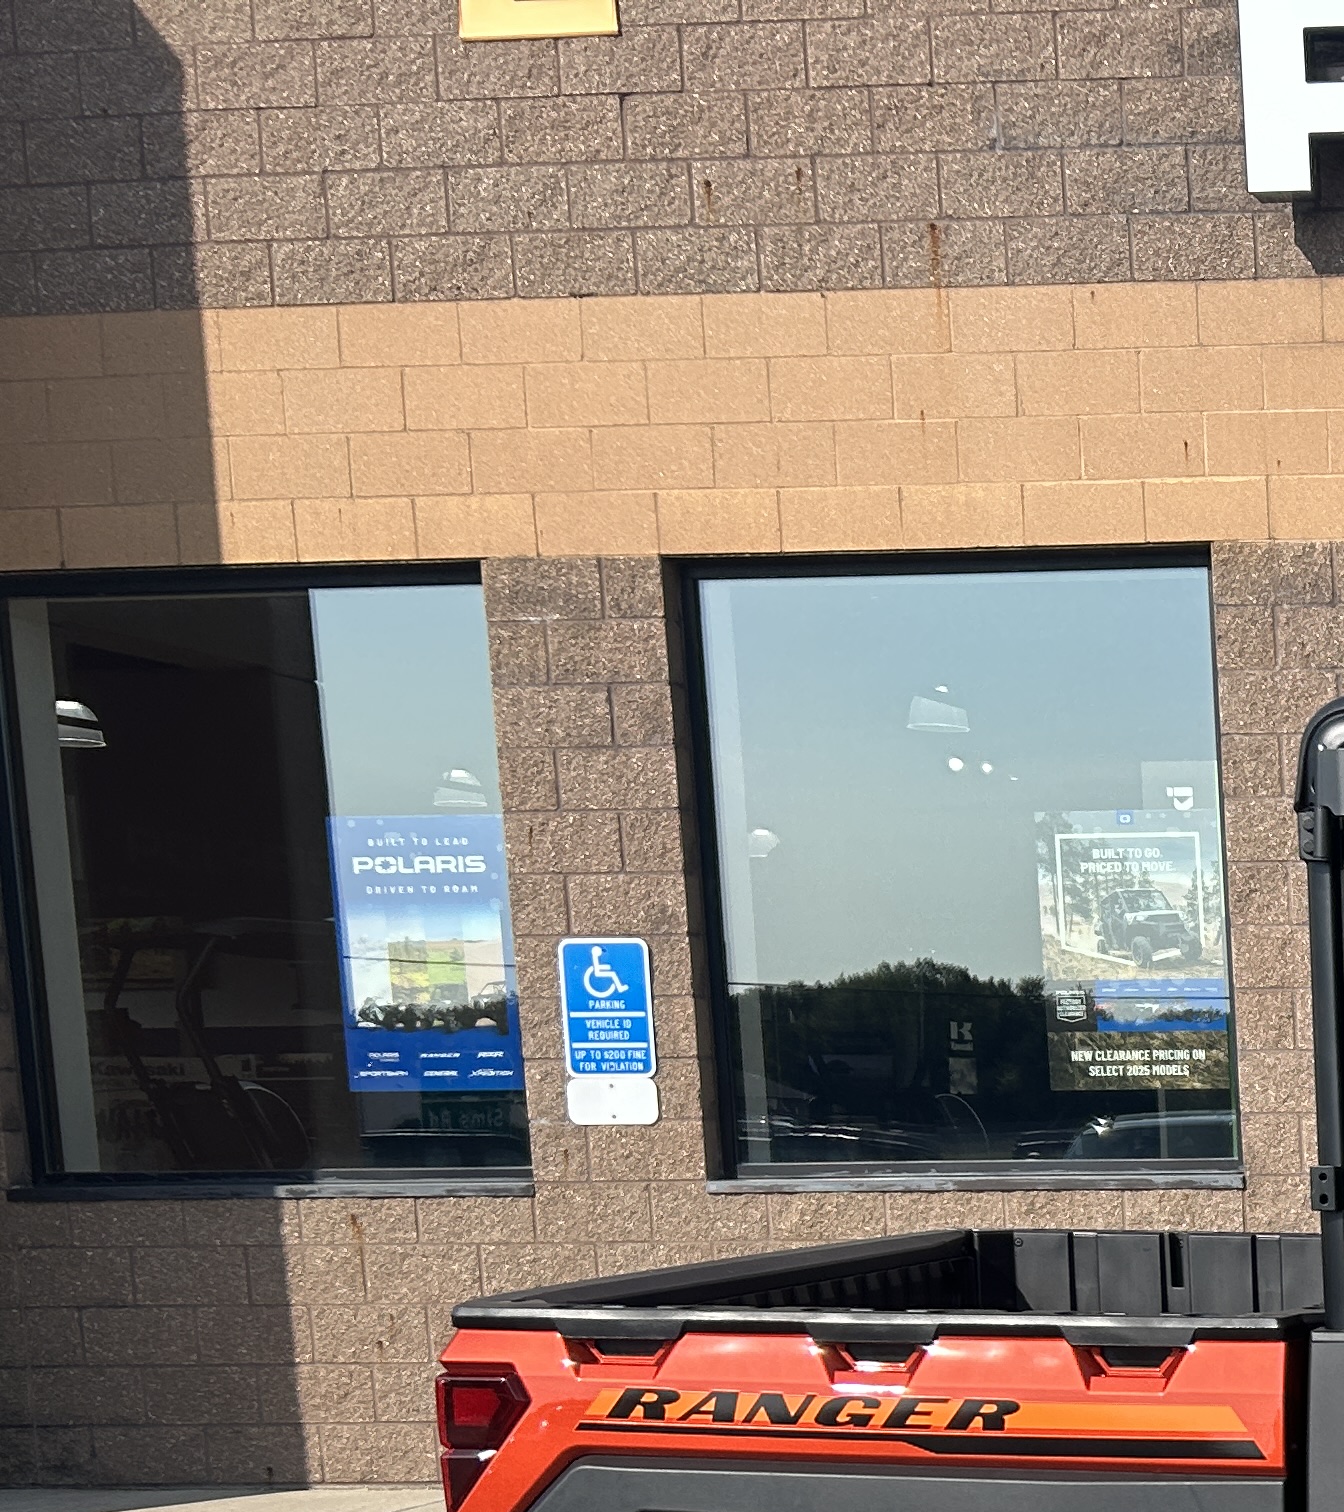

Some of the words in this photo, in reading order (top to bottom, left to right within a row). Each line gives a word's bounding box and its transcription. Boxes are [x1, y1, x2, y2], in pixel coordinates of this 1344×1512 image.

[367, 837, 406, 847] BUILT
[412, 837, 428, 846] TO
[435, 837, 469, 846] LEAD
[1092, 848, 1125, 860] BUILT
[1127, 848, 1142, 859] TO
[1145, 847, 1163, 859] GO.
[352, 855, 487, 875] POLARIS
[1080, 862, 1122, 873] PRICED
[1125, 862, 1139, 873] TO
[366, 885, 414, 894] DRIVEN
[421, 885, 437, 894] TO
[443, 885, 479, 894] ROAM
[588, 1000, 626, 1010] PARKING
[585, 1019, 620, 1029] VEHICLE
[623, 1019, 632, 1029] ID
[588, 1030, 630, 1041] REQUIRED
[575, 1050, 586, 1060] UP
[590, 1050, 601, 1060] TO
[604, 1050, 626, 1060] $200
[627, 1050, 647, 1060] FINE
[1070, 1050, 1093, 1062] NEW
[1095, 1050, 1150, 1062] CLEARANCE
[1152, 1049, 1190, 1061] PRICING
[1192, 1049, 1206, 1061] ON
[94, 1062, 185, 1076] Kawsaki
[580, 1062, 597, 1071] FOR
[601, 1062, 644, 1071] VIOLATION
[1088, 1065, 1123, 1077] SELECT
[1126, 1065, 1150, 1076] 2025
[1152, 1065, 1190, 1077] MODELS
[604, 1387, 1021, 1431] RANGER
